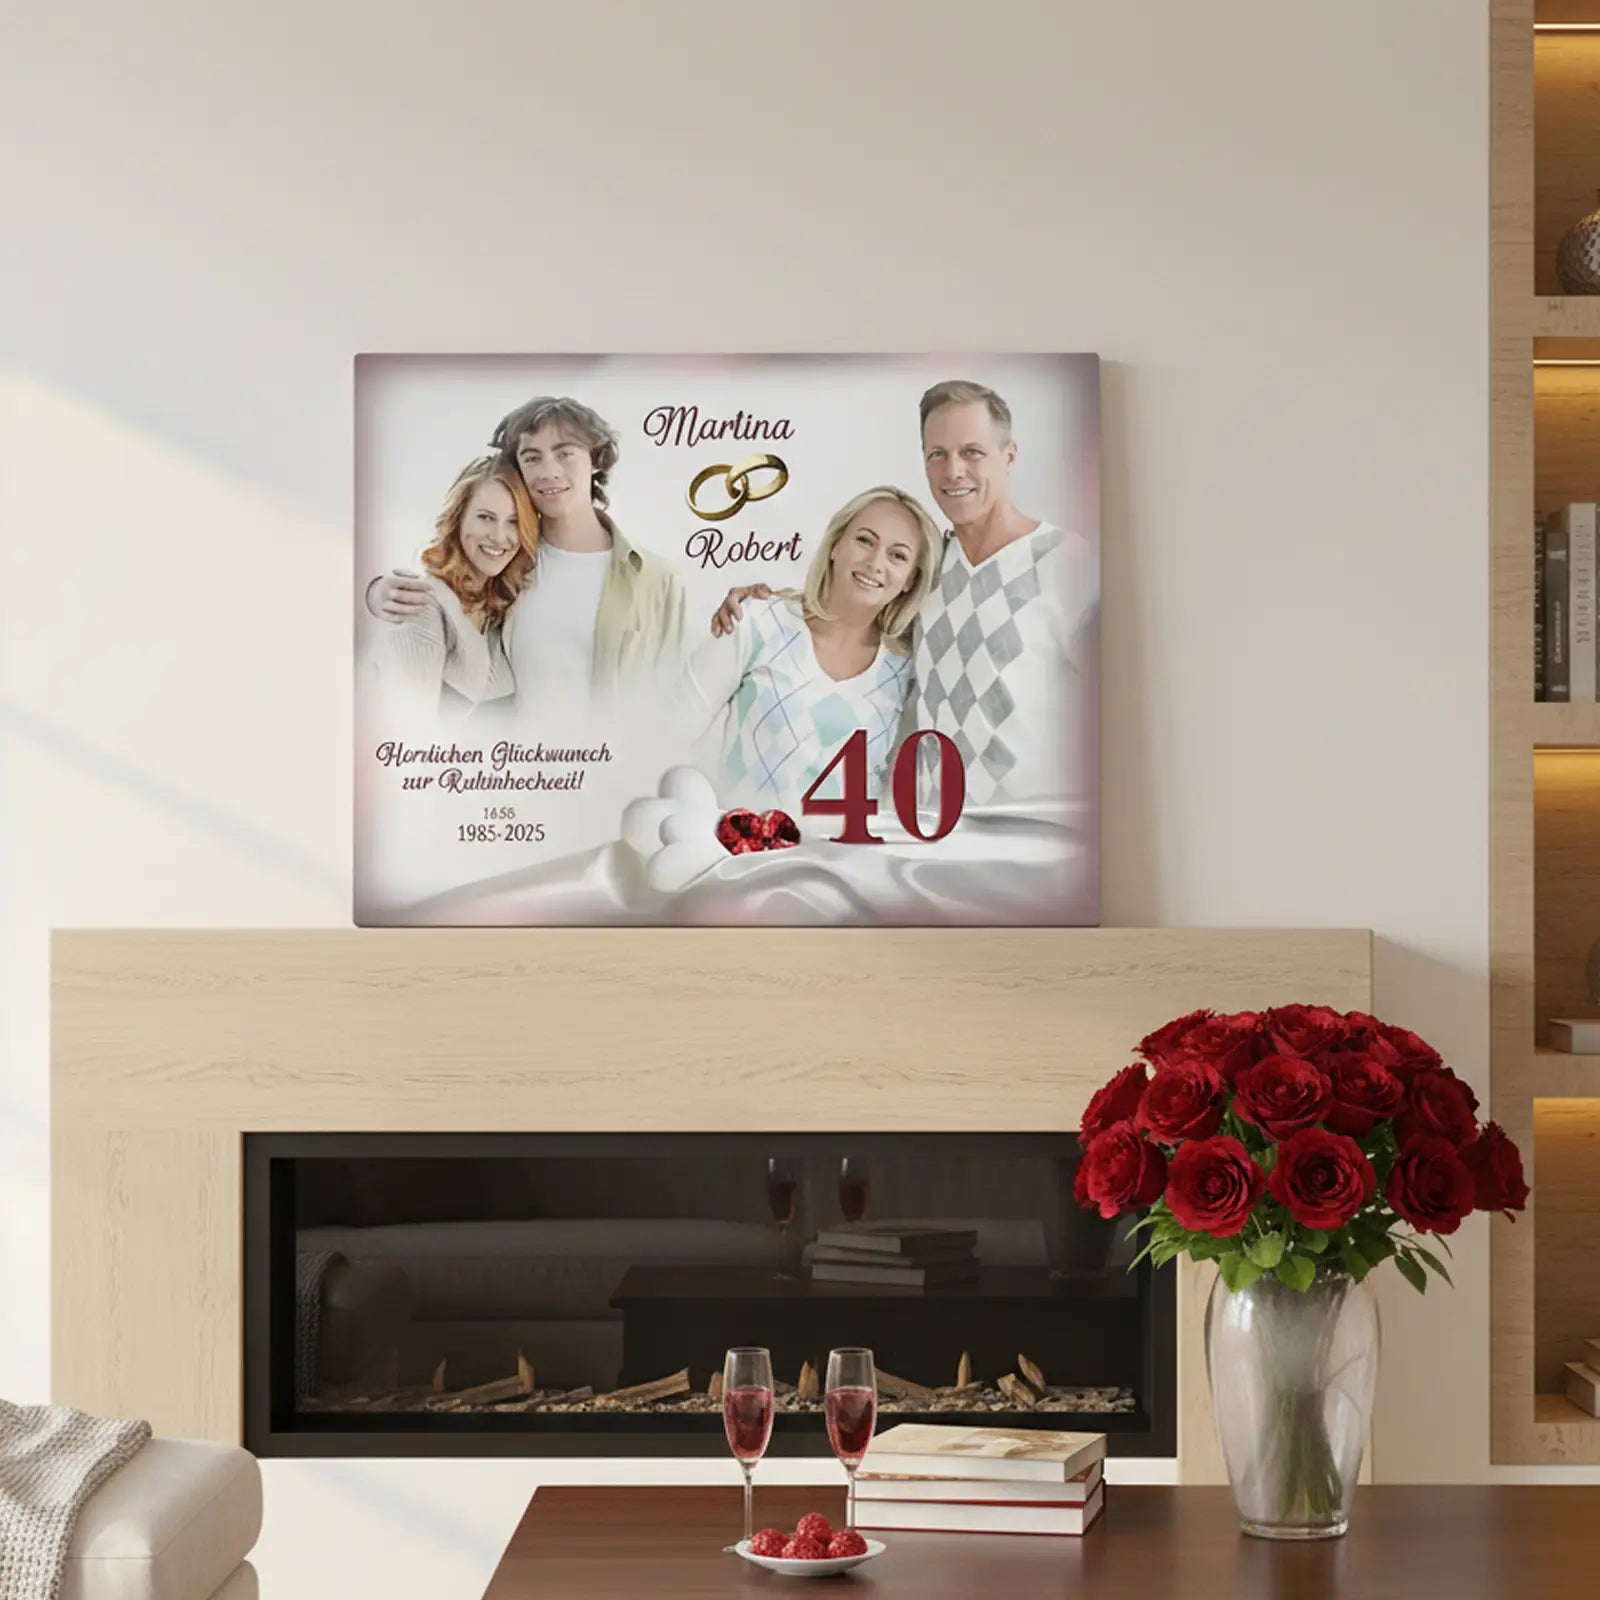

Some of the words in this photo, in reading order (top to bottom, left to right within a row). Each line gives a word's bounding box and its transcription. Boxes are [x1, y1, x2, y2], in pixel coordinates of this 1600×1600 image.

[643, 405, 796, 448] Martina
[685, 528, 803, 569] Robert
[800, 729, 966, 845] 40
